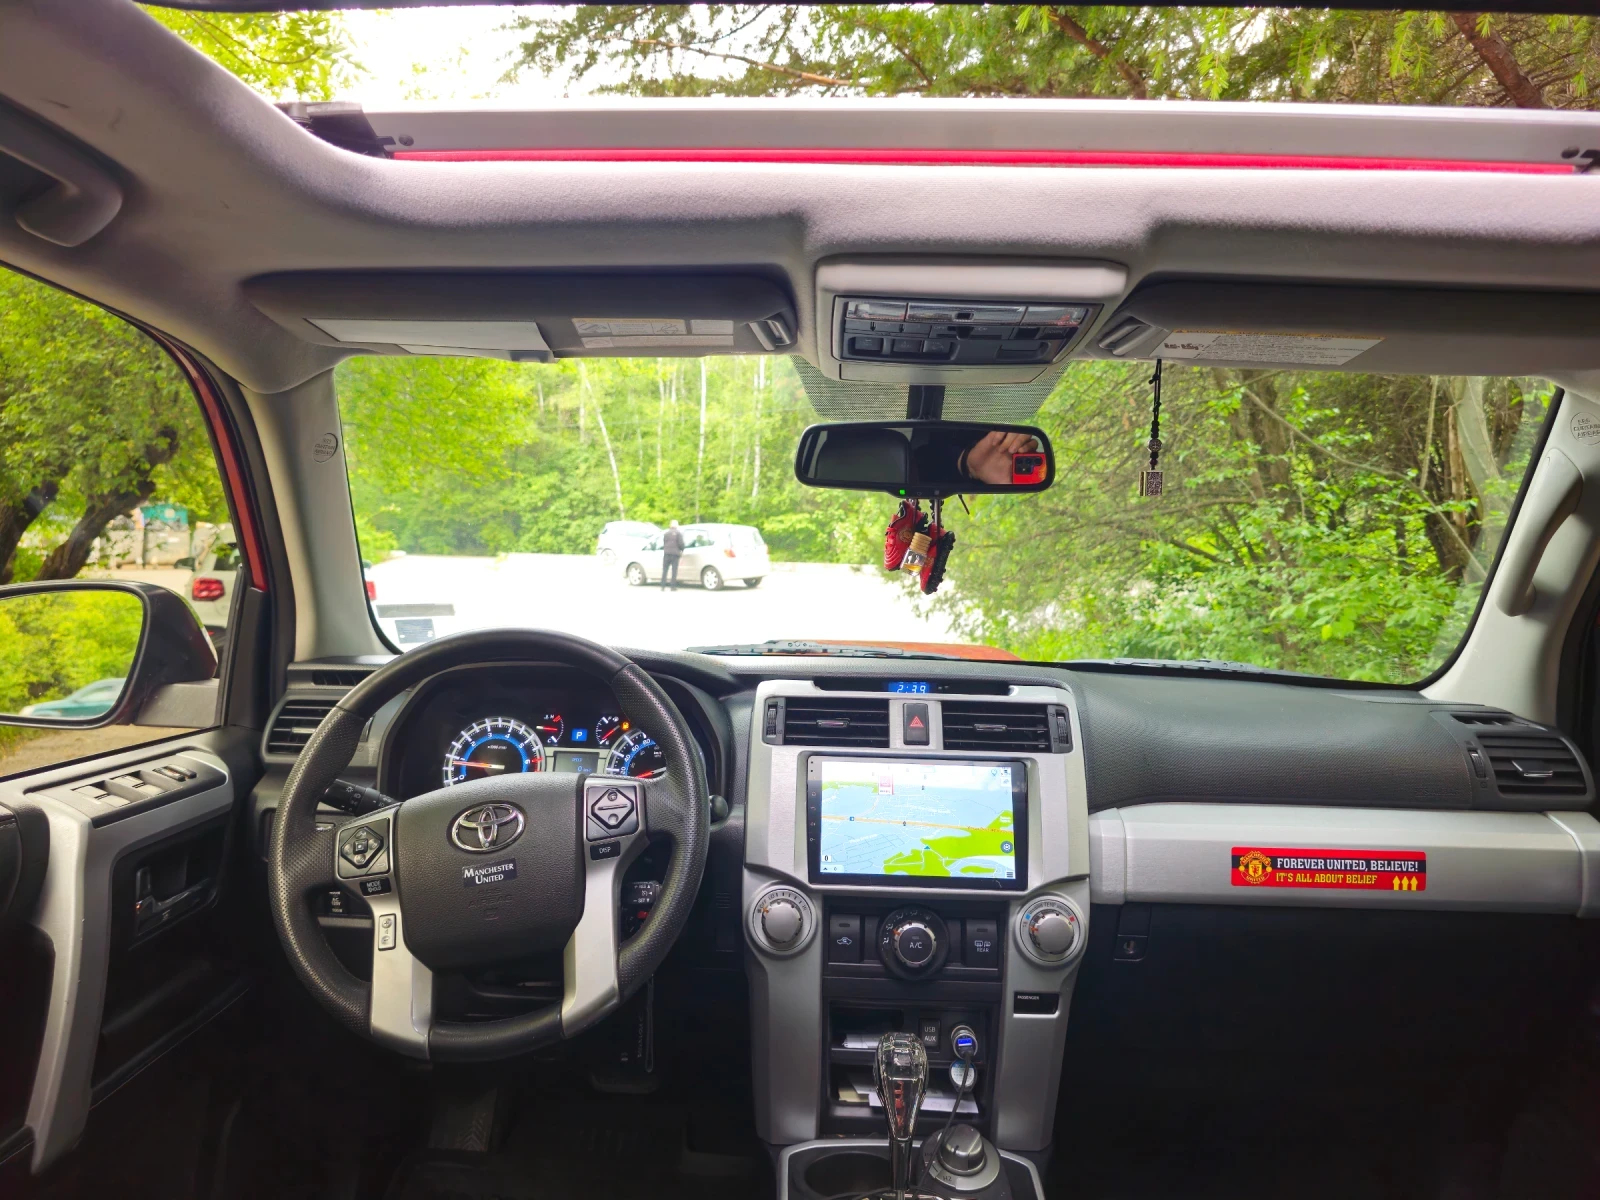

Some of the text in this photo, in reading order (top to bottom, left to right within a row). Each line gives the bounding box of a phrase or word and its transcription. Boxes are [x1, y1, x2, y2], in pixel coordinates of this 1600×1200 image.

[897, 684, 926, 694] 2:39
[576, 731, 582, 740] P
[463, 863, 515, 878] MANCHESTER
[1276, 858, 1419, 872] FOREVER UNITED, BELIEVE!
[475, 874, 504, 885] UNITED
[1276, 872, 1378, 885] IT'S ALL ABOUT BELIEF
[909, 941, 923, 949] A/C
